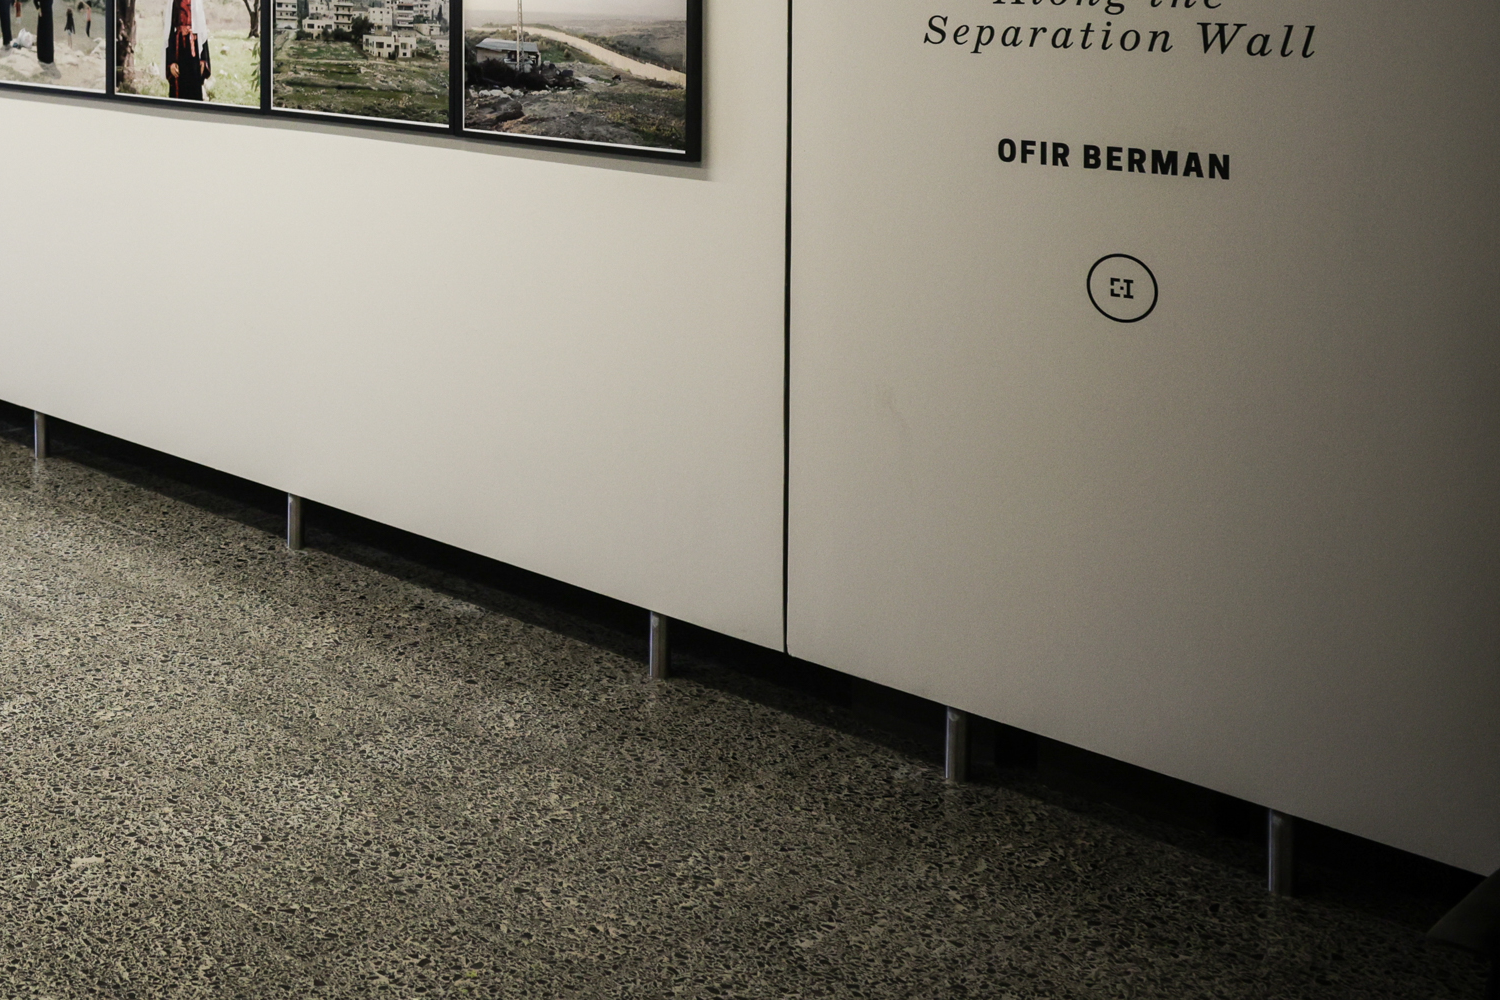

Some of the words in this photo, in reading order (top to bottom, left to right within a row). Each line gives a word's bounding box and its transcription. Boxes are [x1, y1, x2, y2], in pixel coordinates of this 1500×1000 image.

[923, 15, 1174, 55] Separation
[1196, 22, 1316, 59] Wall
[997, 137, 1070, 168] OFIR
[1083, 143, 1230, 181] BERMAN
